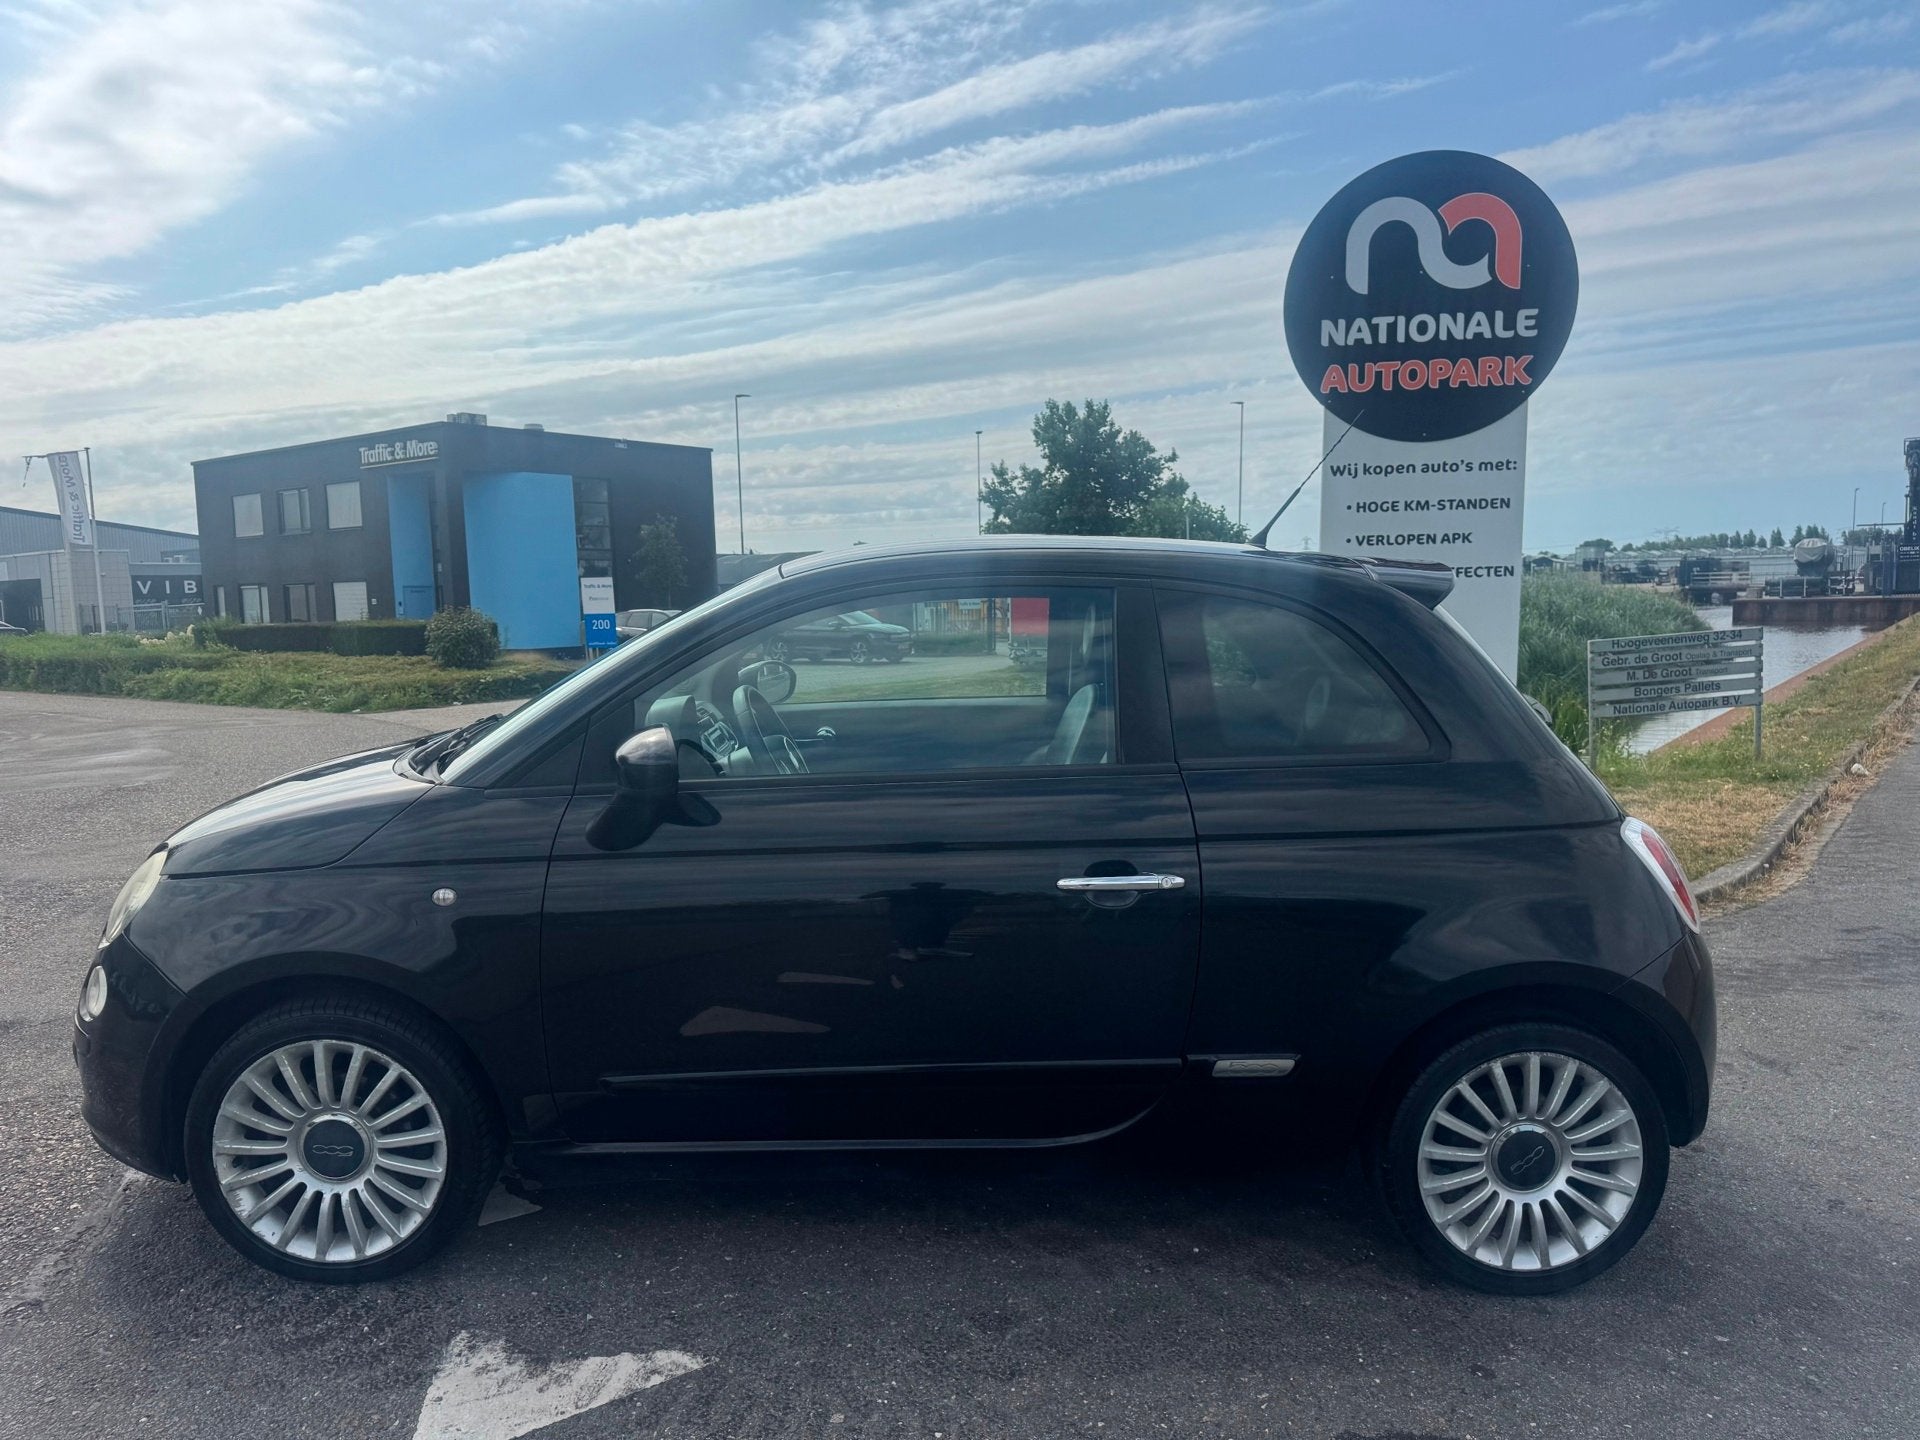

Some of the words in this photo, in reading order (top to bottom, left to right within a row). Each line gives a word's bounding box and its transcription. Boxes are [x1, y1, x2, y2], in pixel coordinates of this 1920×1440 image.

[1320, 308, 1539, 347] NATIONALE
[1320, 355, 1534, 394] AUTOPARK
[359, 443, 394, 464] Traffic
[394, 442, 405, 459] &
[406, 439, 438, 458] More
[1330, 463, 1359, 479] Wij
[1363, 462, 1416, 477] kopen
[1421, 459, 1473, 474] auto's
[1478, 458, 1518, 472] met:
[1356, 500, 1400, 513] HOGE
[1404, 497, 1511, 512] KM-STANDEN
[1355, 533, 1437, 547] VERLOPEN
[1440, 531, 1473, 544] APK
[1451, 565, 1514, 578] FECTEN
[592, 619, 611, 630] 200
[1611, 634, 1710, 649] Hoogeveenenweg
[1713, 630, 1742, 641] 32-34
[1601, 656, 1631, 667] Gebr.
[1634, 654, 1648, 664] de
[1651, 652, 1682, 663] Groot
[1712, 650, 1717, 658] &
[1720, 648, 1752, 658] Transport
[1626, 671, 1639, 681] M.
[1643, 670, 1658, 680] De
[1661, 668, 1692, 679] Groot
[1696, 666, 1728, 675] Transport
[1634, 685, 1680, 697] Bongers
[1684, 681, 1721, 693] Pallets
[1613, 702, 1666, 715] Nationale
[1668, 697, 1718, 711] Autopark
[1722, 695, 1742, 706] B.V.
